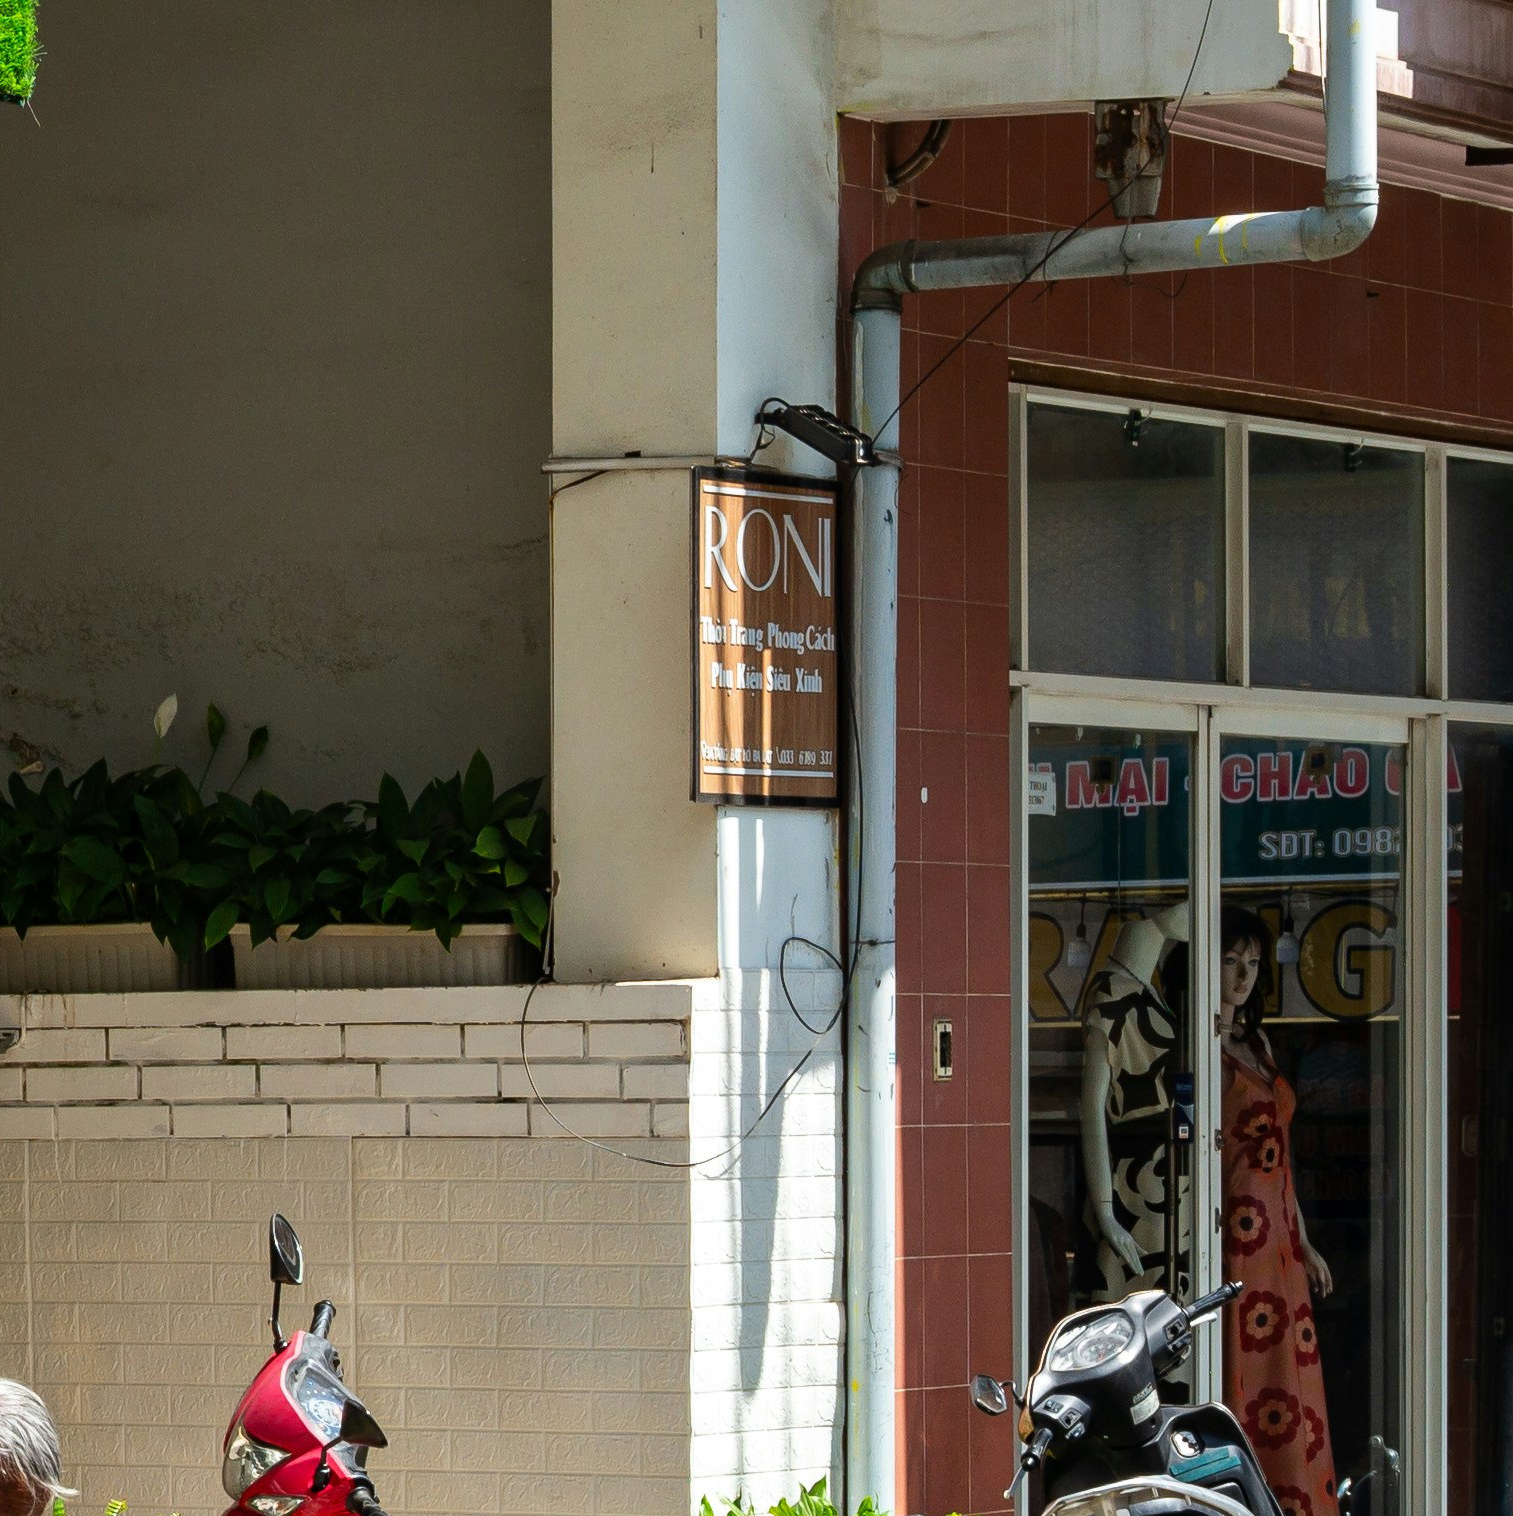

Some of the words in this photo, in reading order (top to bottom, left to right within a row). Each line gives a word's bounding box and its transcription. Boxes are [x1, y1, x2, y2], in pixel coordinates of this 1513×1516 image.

[704, 505, 831, 597] RONI
[729, 618, 764, 652] Trang
[767, 622, 804, 655] Phong
[806, 625, 835, 651] Cách
[711, 662, 733, 696] Phụ
[737, 662, 763, 696] Kiện
[795, 667, 823, 693] Xinh
[1066, 757, 1169, 816] MẠI
[1258, 829, 1326, 860] SĐT:
